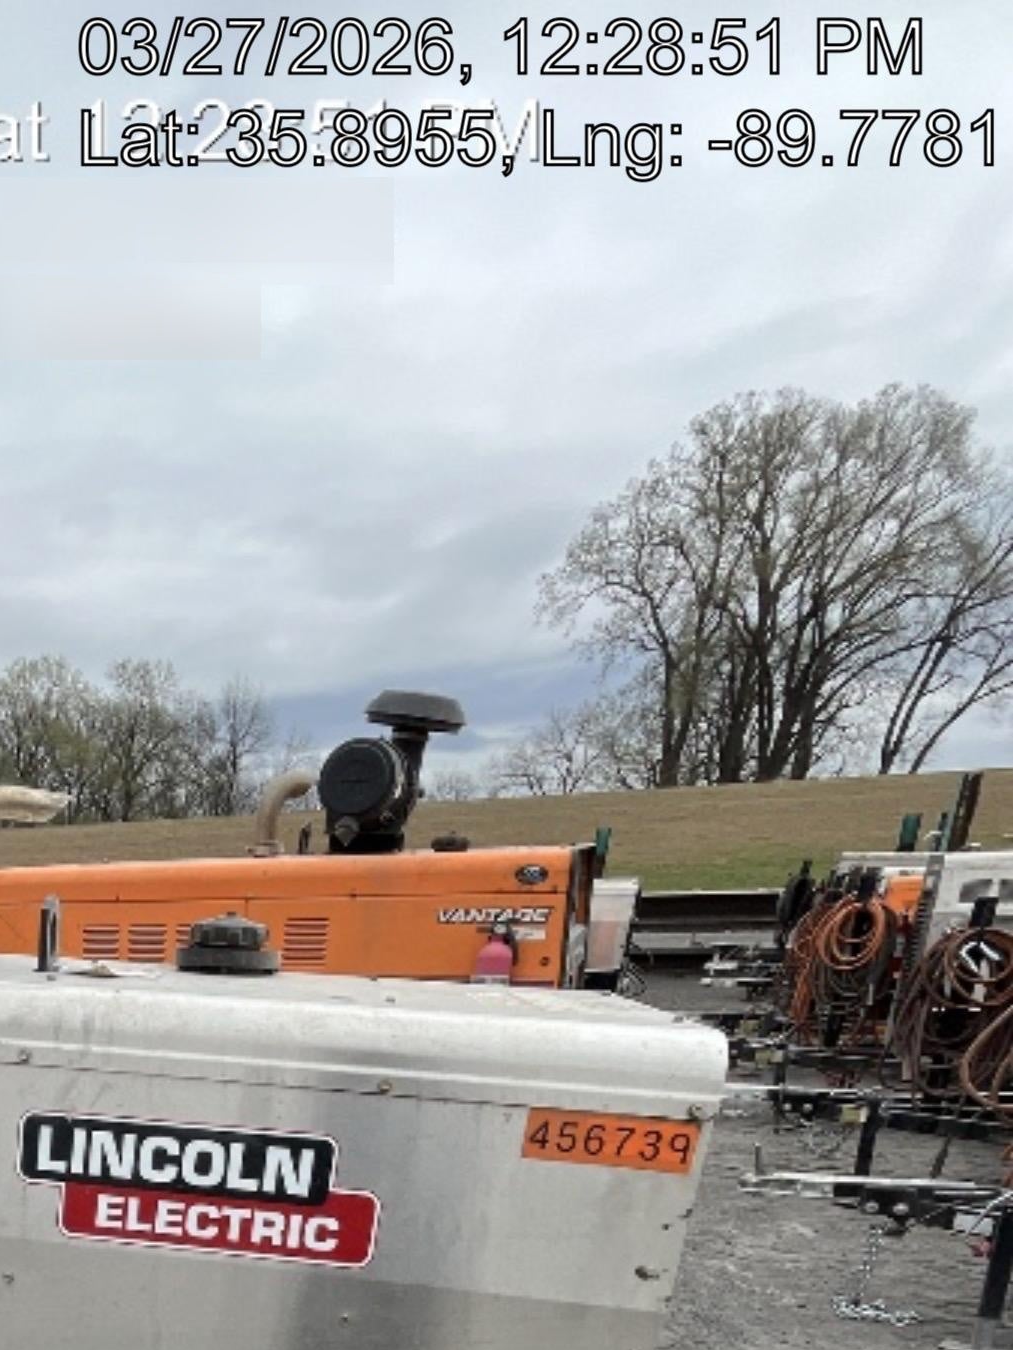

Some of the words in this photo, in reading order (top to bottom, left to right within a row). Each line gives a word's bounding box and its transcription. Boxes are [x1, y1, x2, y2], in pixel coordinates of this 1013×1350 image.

[36, 1123, 316, 1199] LINCOLN
[528, 1119, 691, 1165] 456739
[94, 1193, 340, 1252] ELECTRIC
